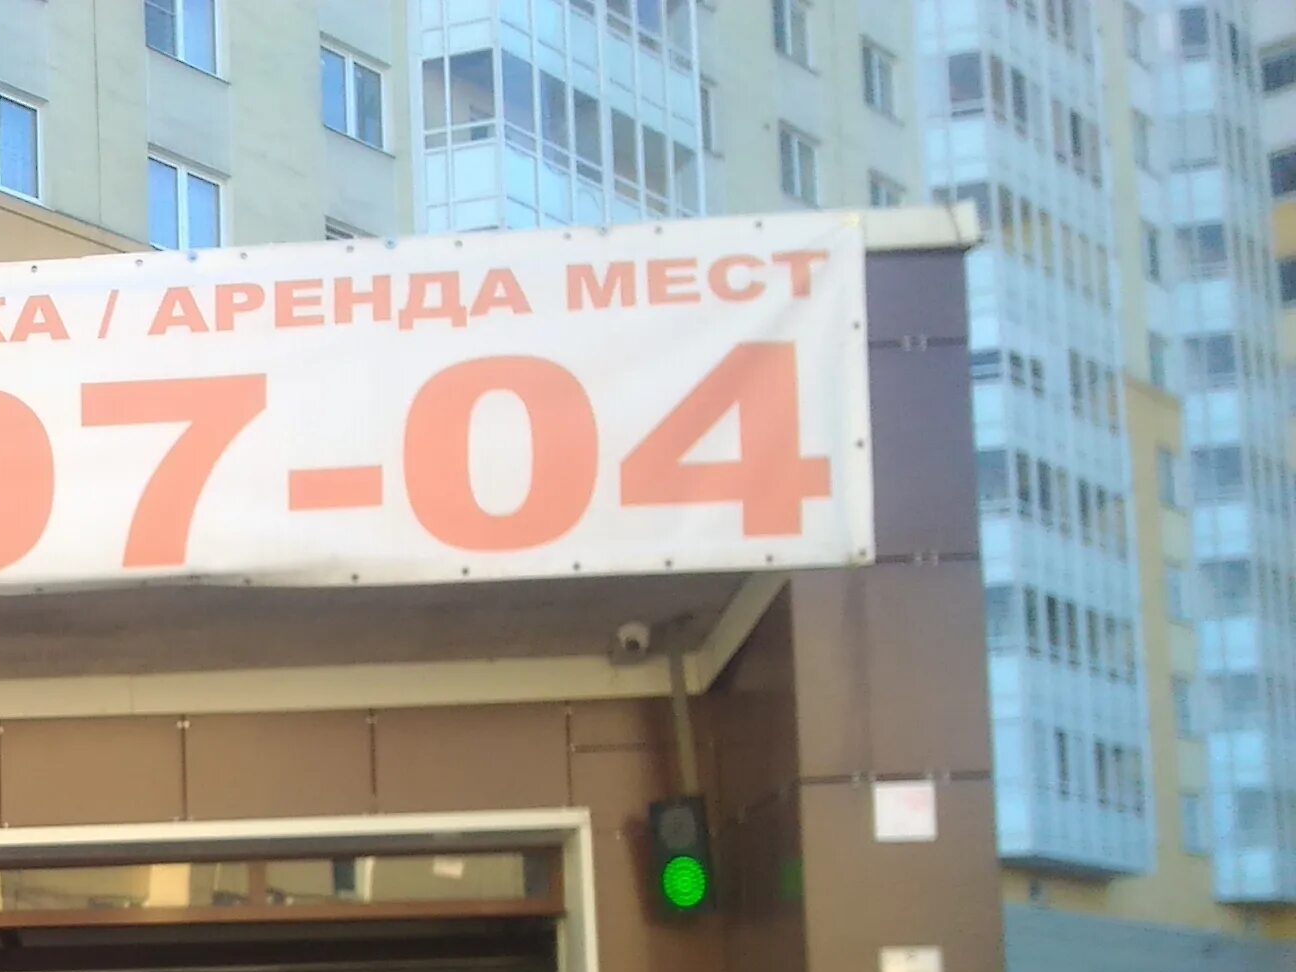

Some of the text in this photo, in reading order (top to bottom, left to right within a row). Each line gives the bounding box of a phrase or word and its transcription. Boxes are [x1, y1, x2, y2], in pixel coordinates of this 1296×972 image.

[98, 294, 118, 339] /
[148, 268, 533, 336] АРЕНДА
[566, 249, 833, 311] МЕСТ
